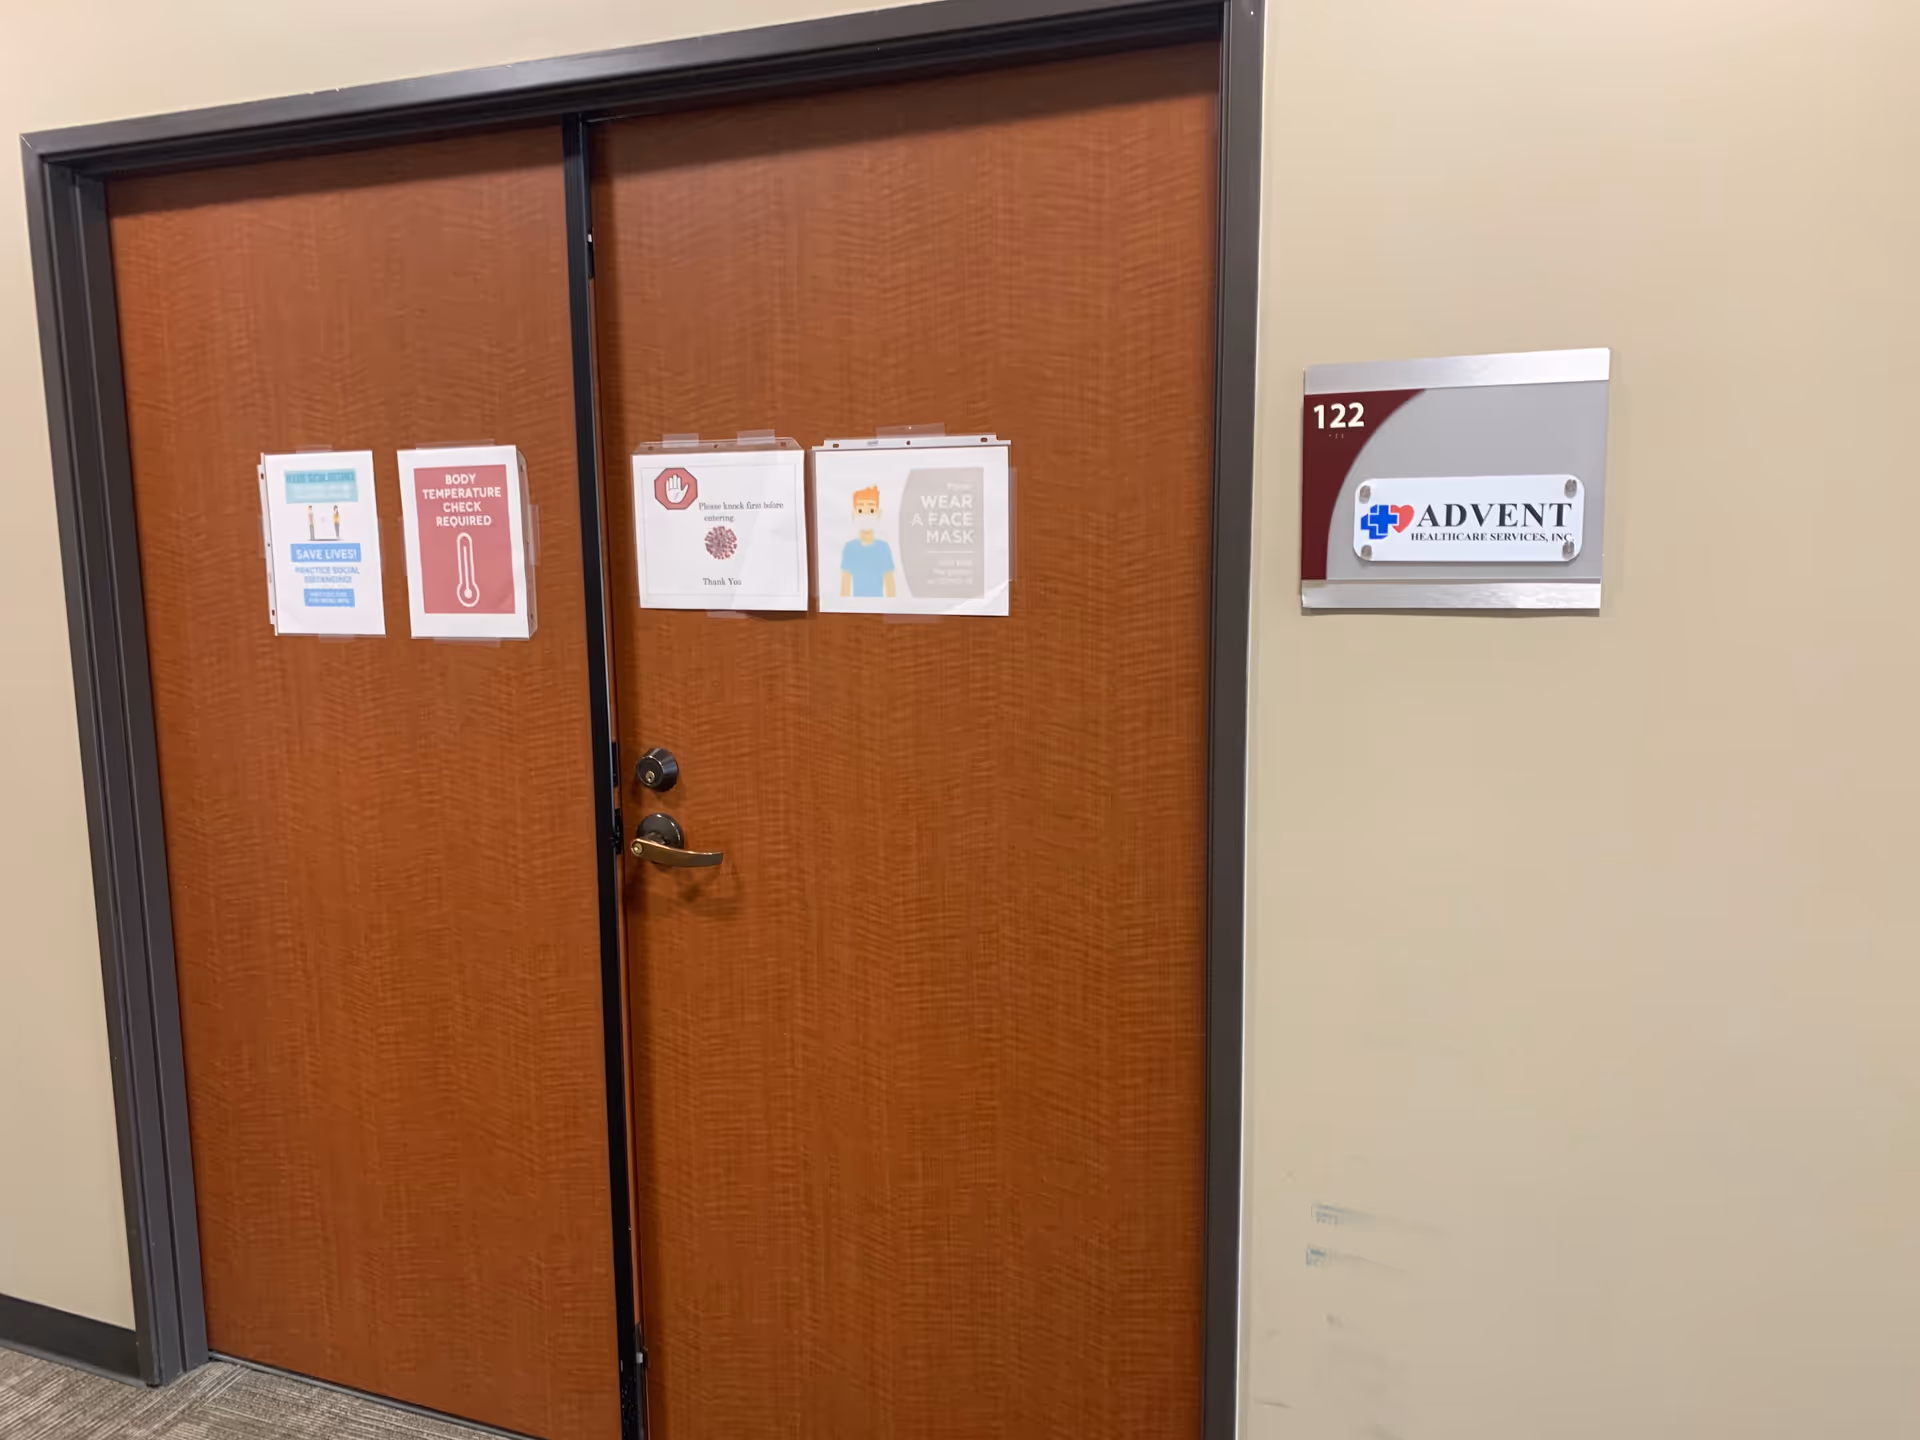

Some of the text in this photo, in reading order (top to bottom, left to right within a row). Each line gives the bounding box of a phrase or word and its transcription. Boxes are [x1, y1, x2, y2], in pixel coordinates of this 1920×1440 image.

[1313, 402, 1365, 429] 122
[445, 473, 477, 485] BODY
[422, 487, 502, 499] TEMPERATURE
[443, 502, 482, 513] CHECK
[698, 501, 784, 511] Please knock first before
[921, 495, 973, 509] WEAR
[436, 515, 492, 527] REQUIRED
[911, 512, 973, 526] A FACE
[1416, 503, 1572, 528] ADVENT
[926, 530, 974, 544] MASK
[1411, 532, 1488, 541] HEALTHCARE
[1489, 532, 1549, 542] SERVICES,
[296, 548, 357, 560] SAVE LIVES!
[702, 577, 742, 585] Thank You
